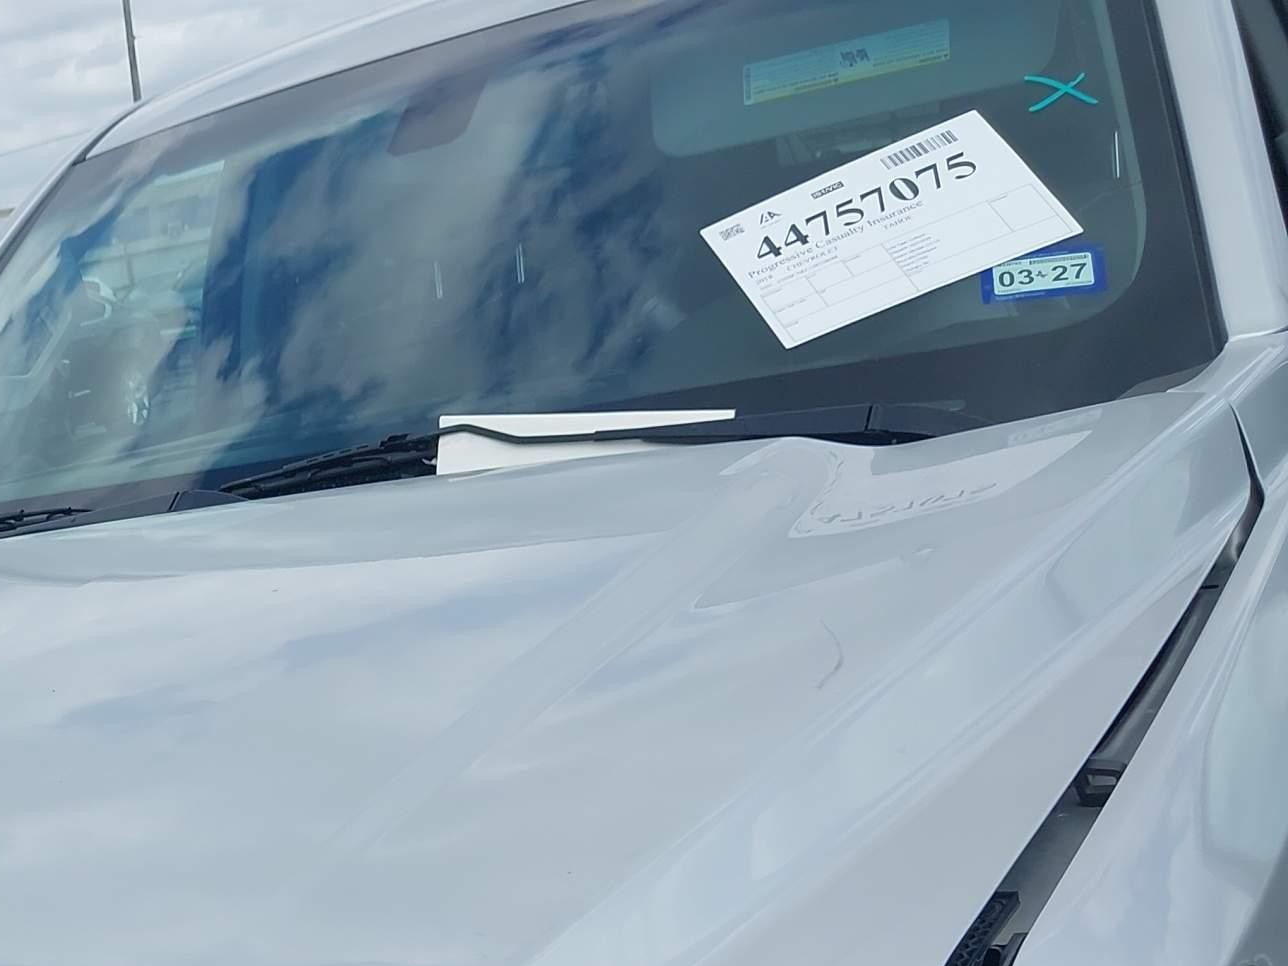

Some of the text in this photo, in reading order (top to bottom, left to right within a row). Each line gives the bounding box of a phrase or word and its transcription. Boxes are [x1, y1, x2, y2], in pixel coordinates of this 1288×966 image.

[748, 247, 813, 278] Progressive
[815, 222, 864, 249] Casualty
[867, 200, 924, 227] Insurance
[757, 152, 977, 259] 44757075
[998, 262, 1087, 288] 03 27
